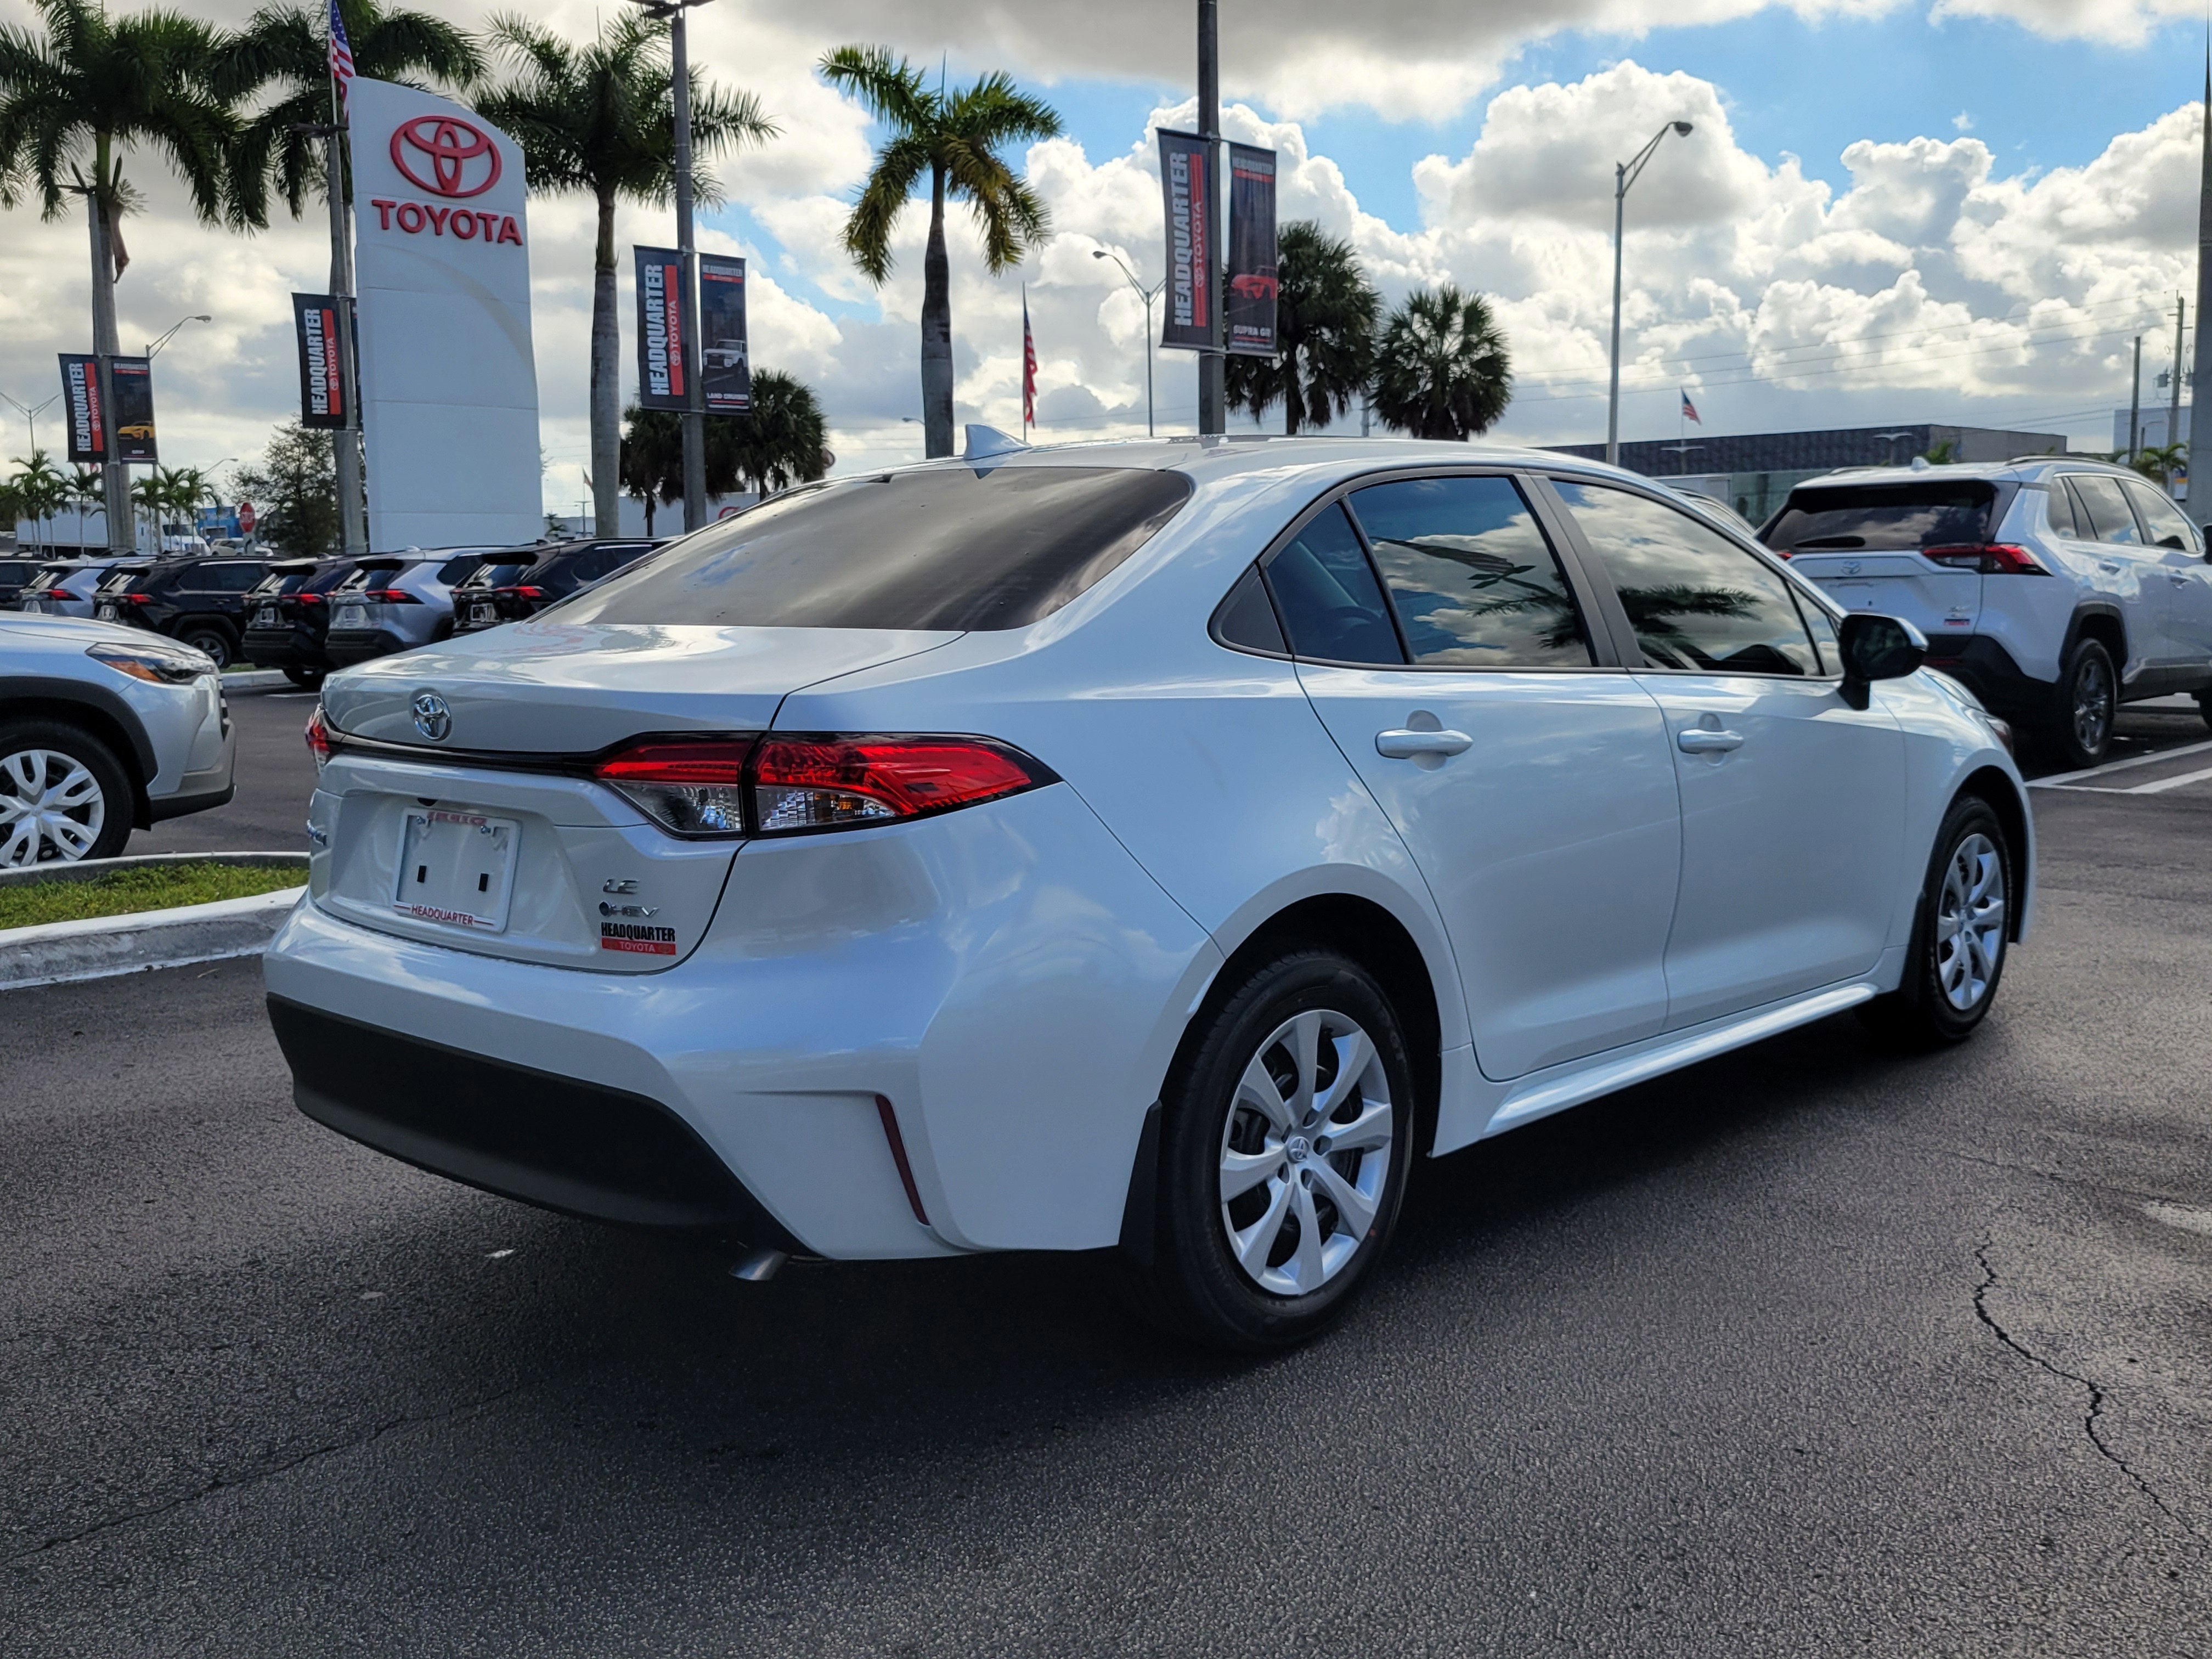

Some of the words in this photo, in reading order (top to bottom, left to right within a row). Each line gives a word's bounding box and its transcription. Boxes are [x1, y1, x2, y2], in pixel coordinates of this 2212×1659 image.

[371, 199, 523, 246] TOYOTA
[1170, 152, 1193, 326] HEADQUARTER
[1192, 201, 1203, 262] TOYOTA
[645, 264, 670, 395] HEADQUARTER
[669, 300, 679, 349] TOYOTA
[304, 308, 328, 415] HEADQUARTER
[326, 337, 337, 376] TOYOTA
[69, 363, 92, 452] HEADQUARTER
[89, 387, 99, 424] TOYOTA
[603, 879, 640, 894] LE
[411, 905, 473, 926] HEADQUARTER
[601, 922, 675, 941] HEADQUARTER
[619, 941, 656, 953] TOYOTA
